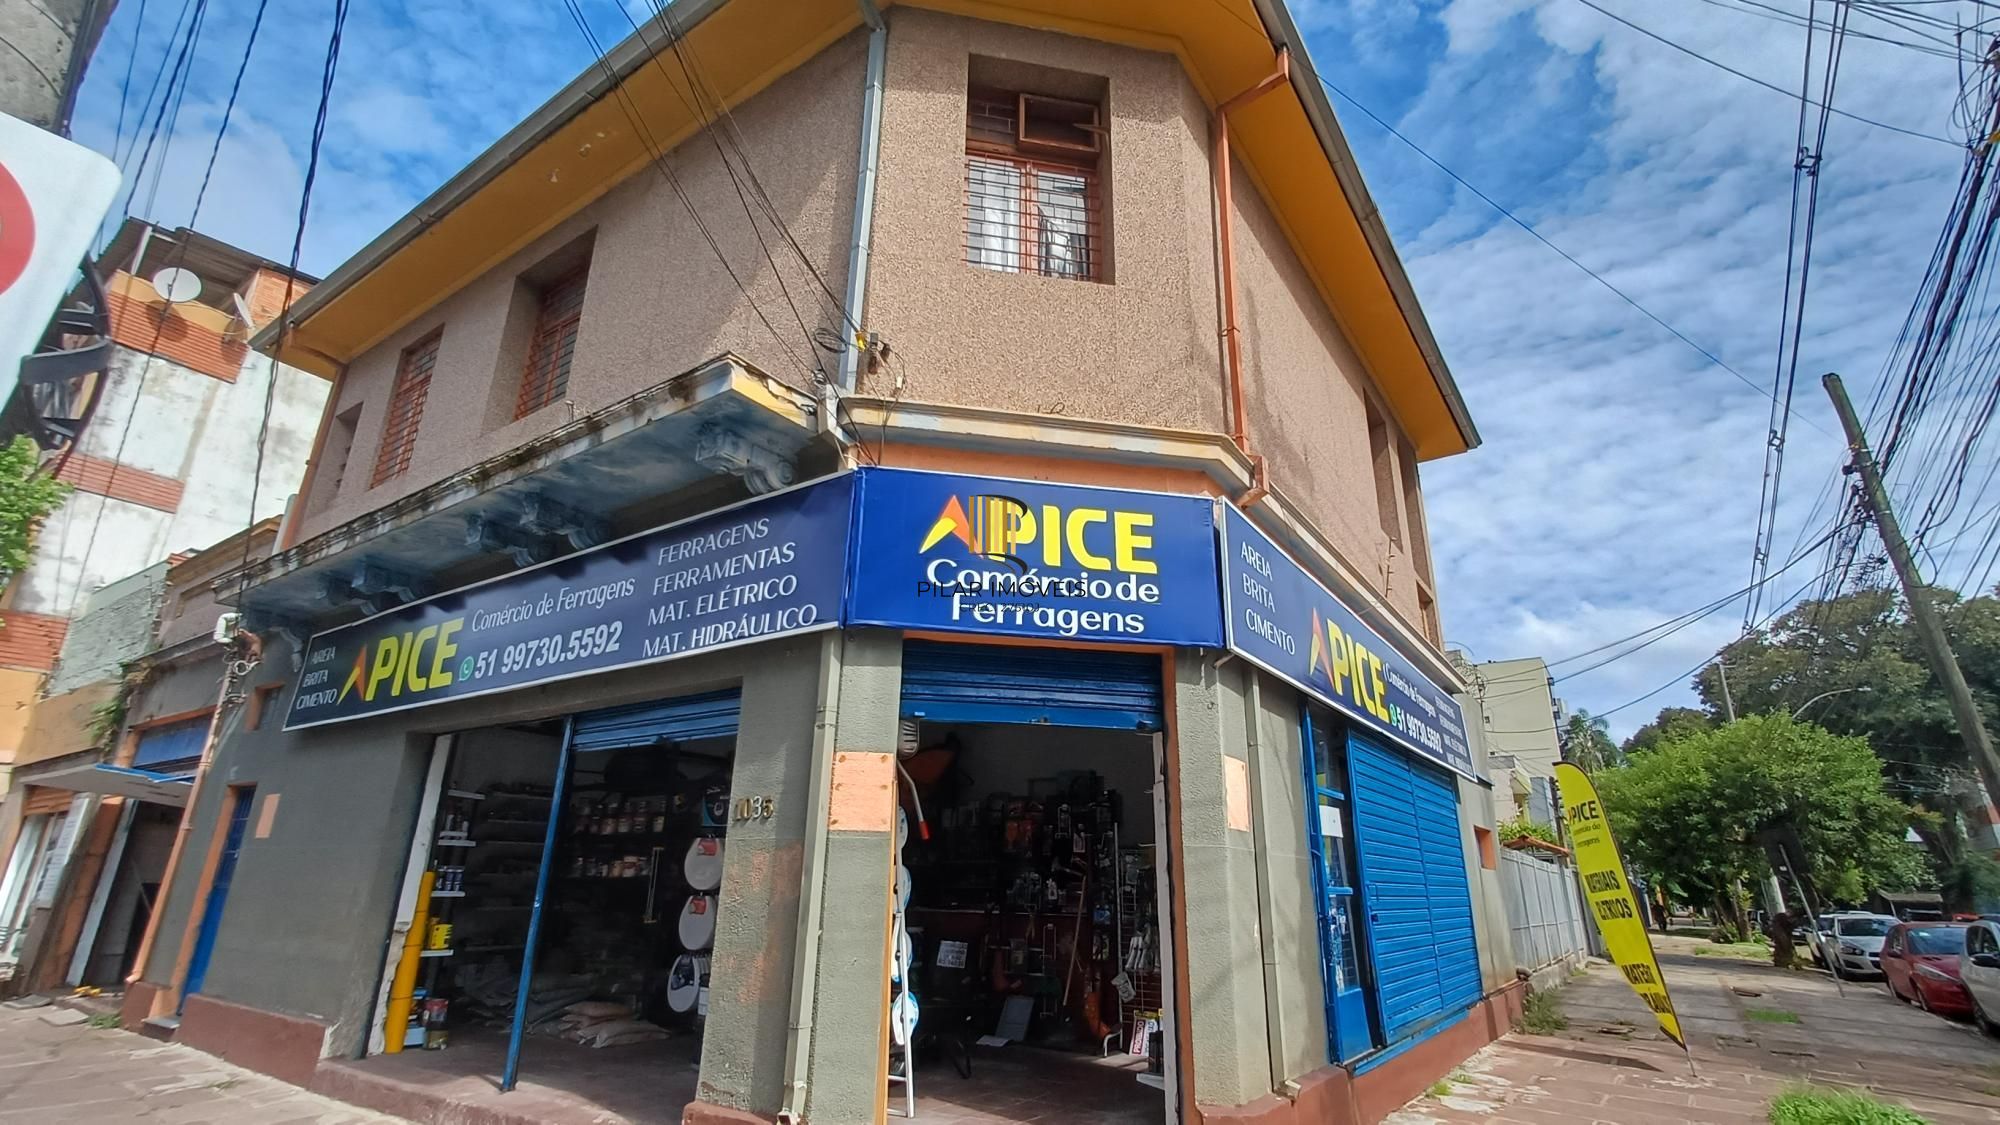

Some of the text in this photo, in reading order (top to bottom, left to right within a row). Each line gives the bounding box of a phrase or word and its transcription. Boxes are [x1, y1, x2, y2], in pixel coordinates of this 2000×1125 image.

[658, 518, 770, 566] FERRAGENS
[1241, 541, 1273, 581] AREIA
[652, 542, 796, 595] FERRAMENTAS
[472, 577, 636, 632] Comércio de Ferragens
[648, 574, 797, 626] MAT. ELÉTRICO
[952, 592, 1145, 637] Ferragens
[1242, 573, 1276, 613] BRITA
[474, 621, 623, 679] 51 99730.5592
[642, 604, 817, 658] MAT. HIDRÁULICO
[1245, 608, 1296, 656] CIMENTO
[296, 688, 338, 709] CIMENTO
[302, 669, 329, 687] BRITA
[1396, 706, 1407, 733] 51
